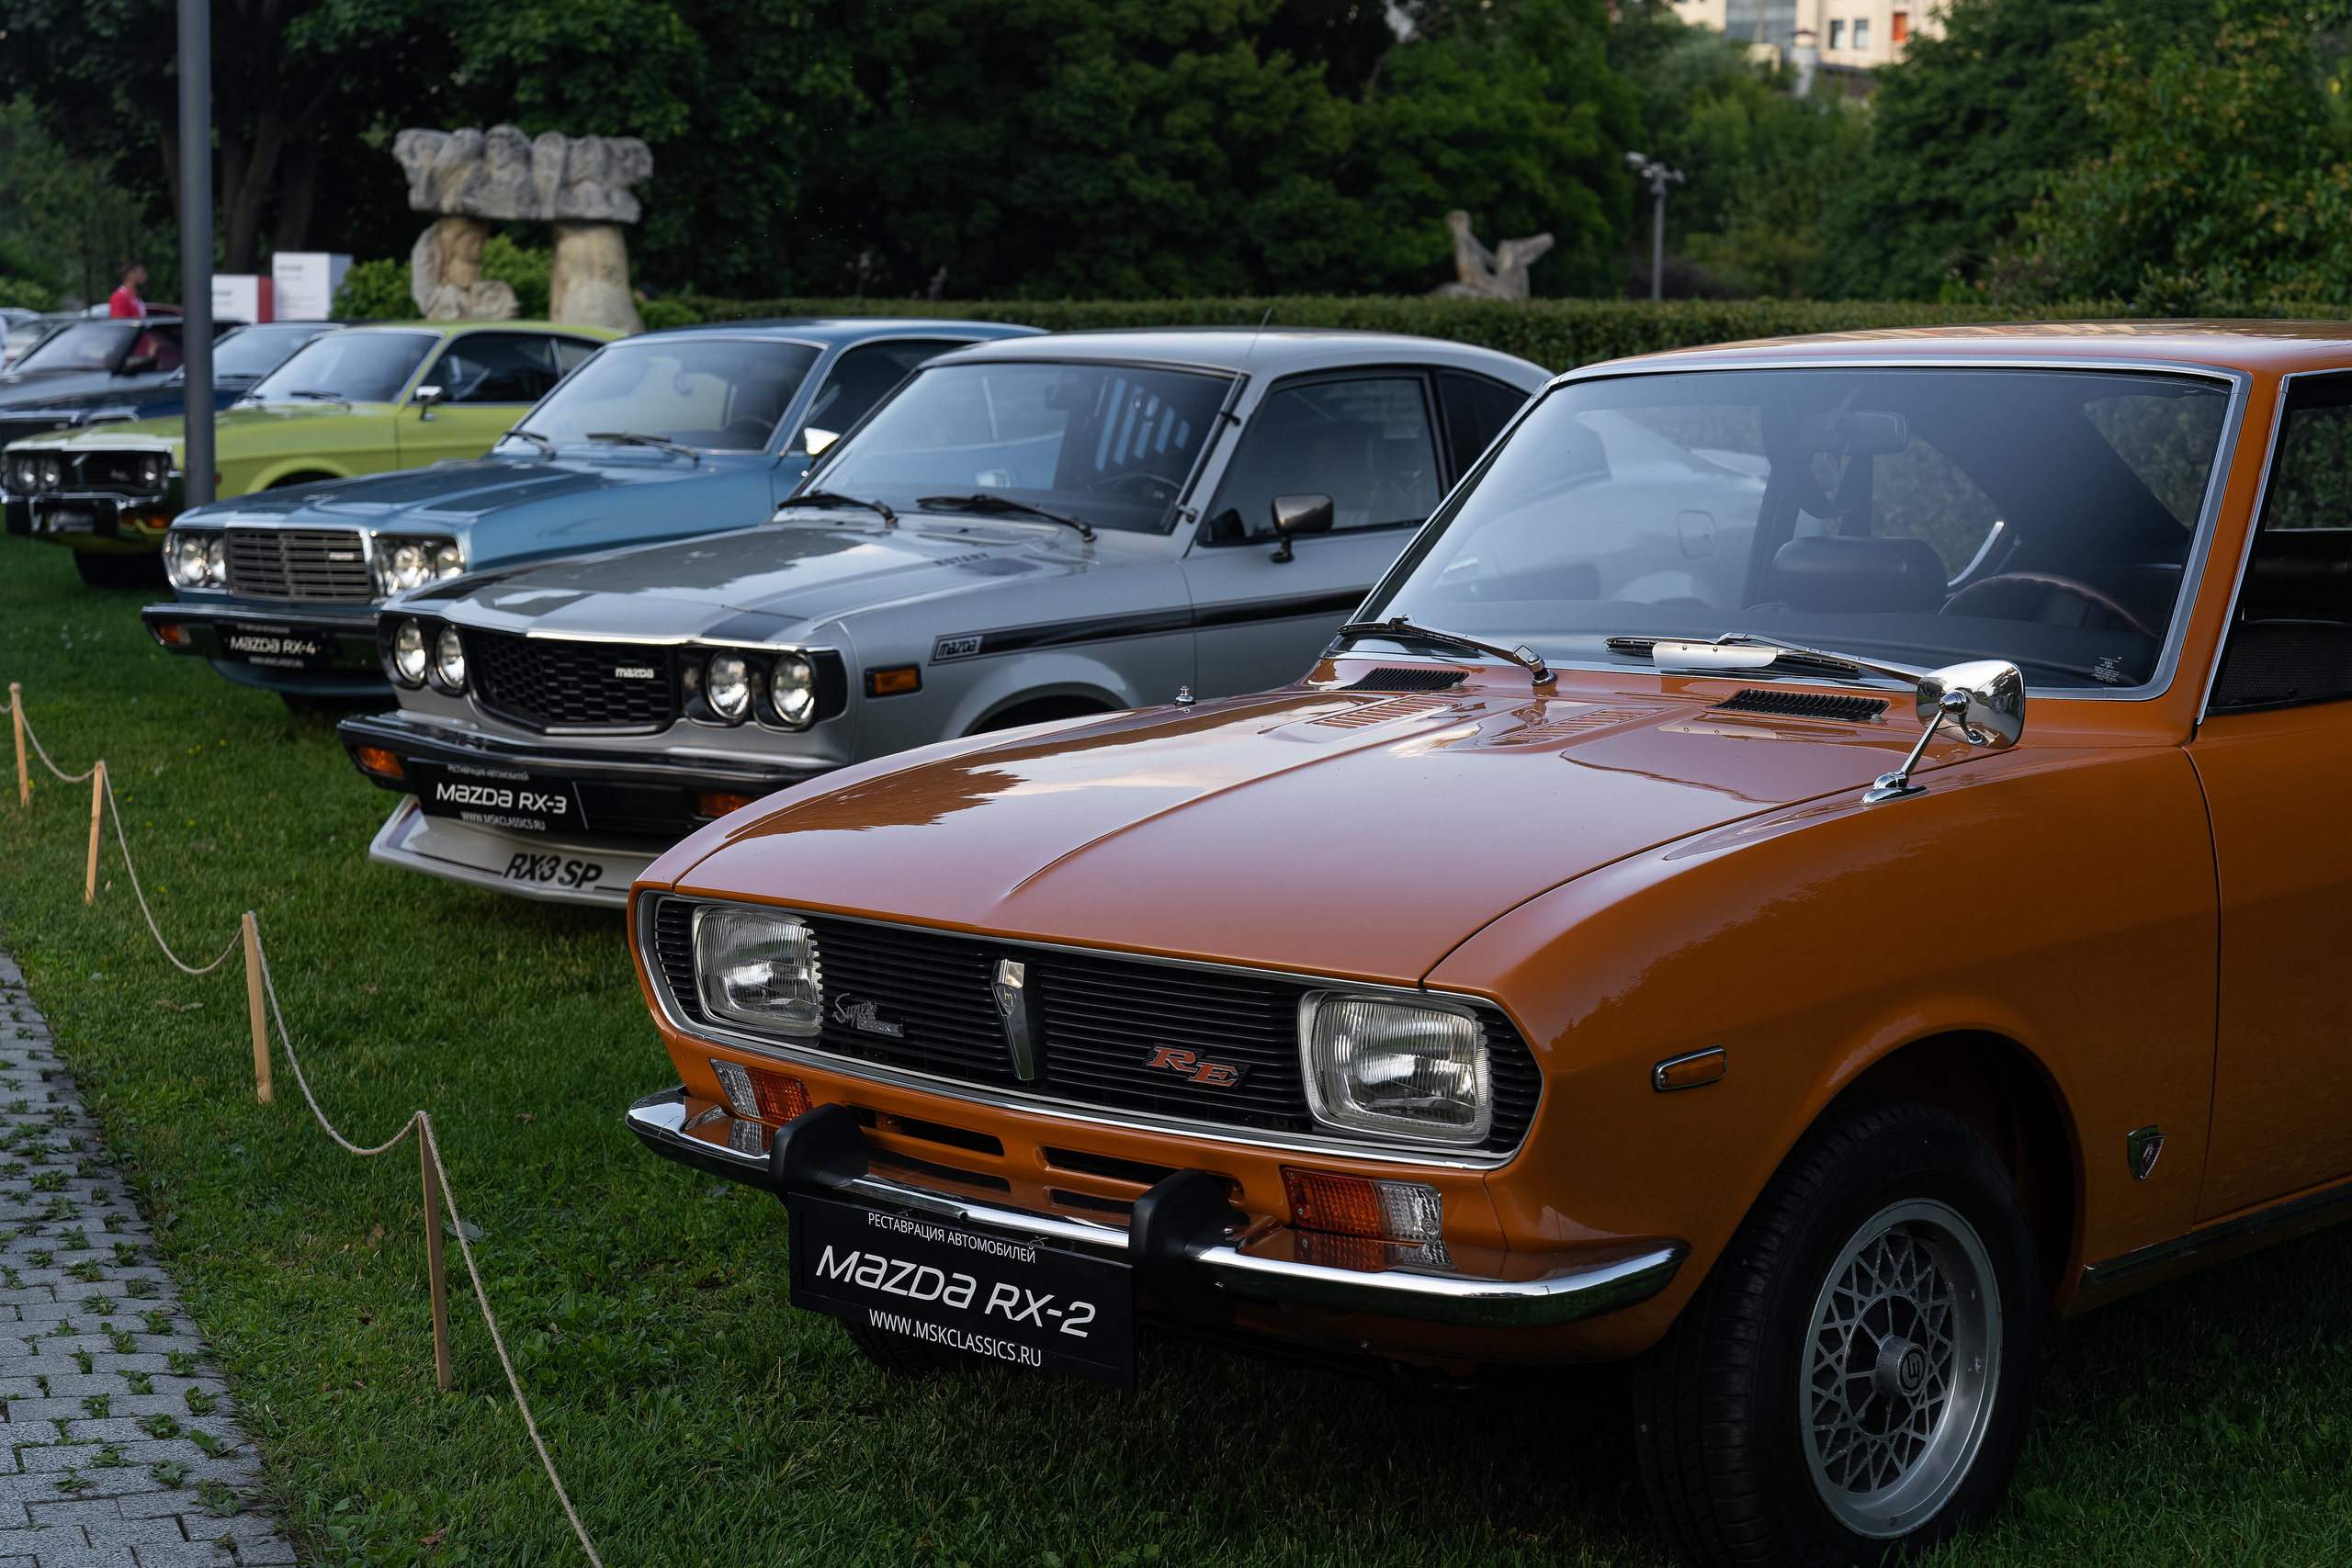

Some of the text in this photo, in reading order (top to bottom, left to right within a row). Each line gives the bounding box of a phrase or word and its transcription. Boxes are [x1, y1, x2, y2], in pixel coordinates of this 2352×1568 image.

[282, 638, 316, 656] RX-4
[517, 791, 567, 815] RX-3
[503, 852, 603, 889] RX3 SP
[1147, 1046, 1238, 1087] RE
[867, 1212, 1036, 1265] РЕСТАВРАЦИЯ АВТОМОБИЛЕЙ
[984, 1282, 1097, 1338] RX-2
[868, 1308, 1043, 1368] WWW.MSKCLASSICS.RU
